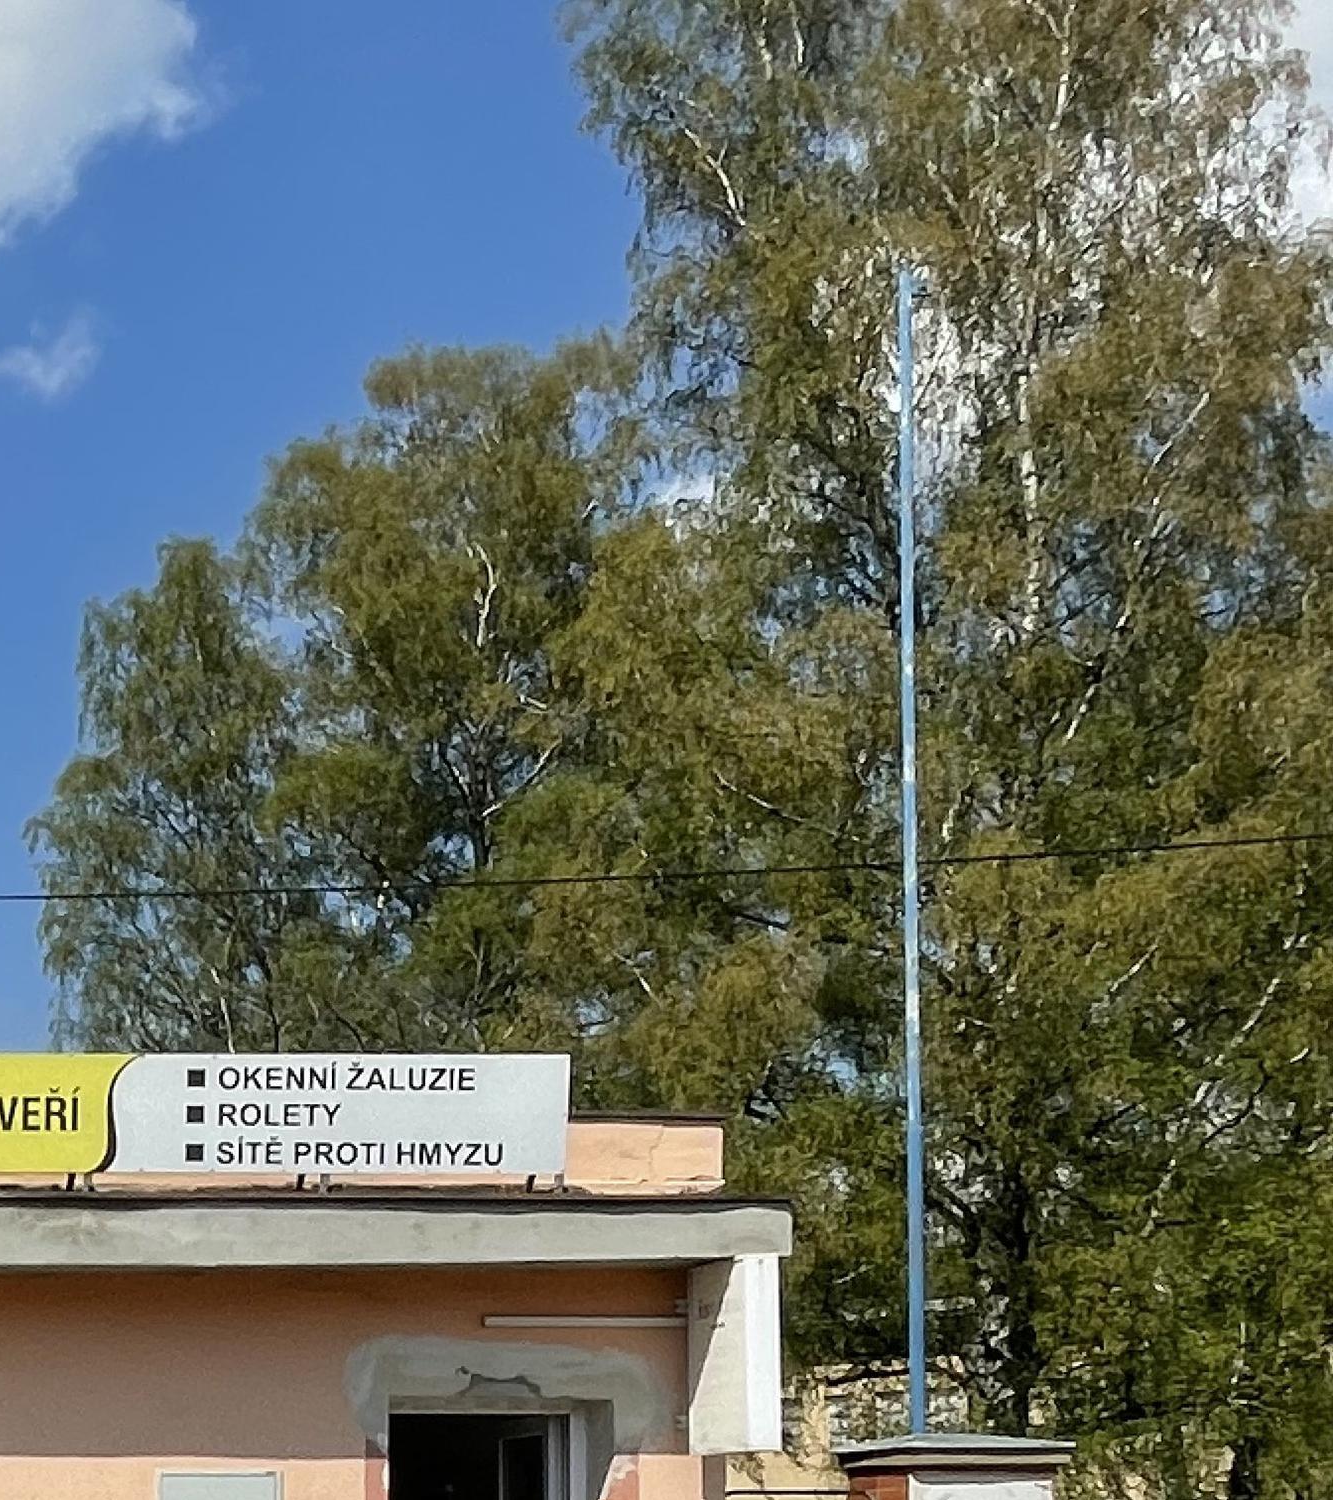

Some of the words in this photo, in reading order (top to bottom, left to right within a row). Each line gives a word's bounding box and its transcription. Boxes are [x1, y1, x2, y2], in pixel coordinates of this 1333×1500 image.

[218, 1061, 337, 1091] OKENNÍ
[345, 1062, 476, 1091] ŽALUZIE
[218, 1103, 341, 1127] ROLETY
[216, 1136, 283, 1165] SÍTĚ
[294, 1141, 385, 1166] PROTI
[396, 1142, 503, 1167] HMYZU
